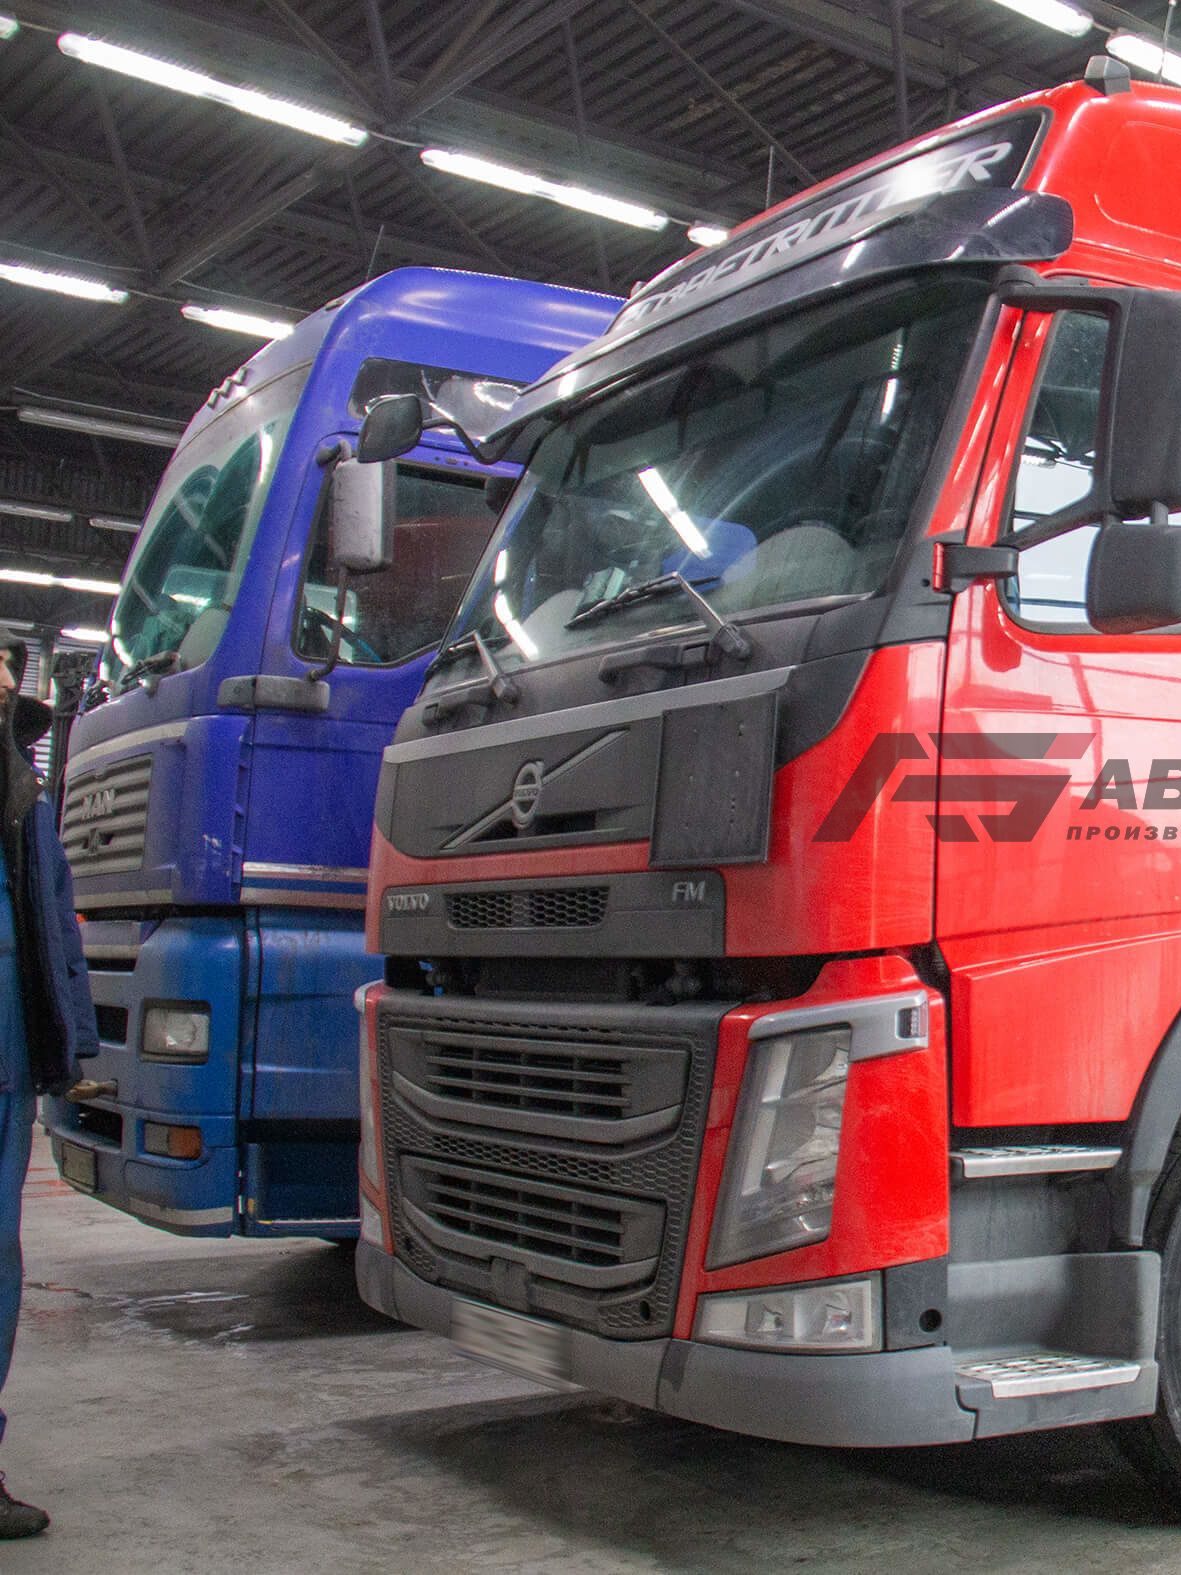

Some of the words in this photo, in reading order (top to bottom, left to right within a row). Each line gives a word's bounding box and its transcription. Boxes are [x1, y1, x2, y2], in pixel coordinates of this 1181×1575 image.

[612, 142, 1013, 326] BETROTTER
[80, 788, 115, 820] MAN
[386, 892, 430, 911] VOLVO
[671, 880, 706, 903] FM
